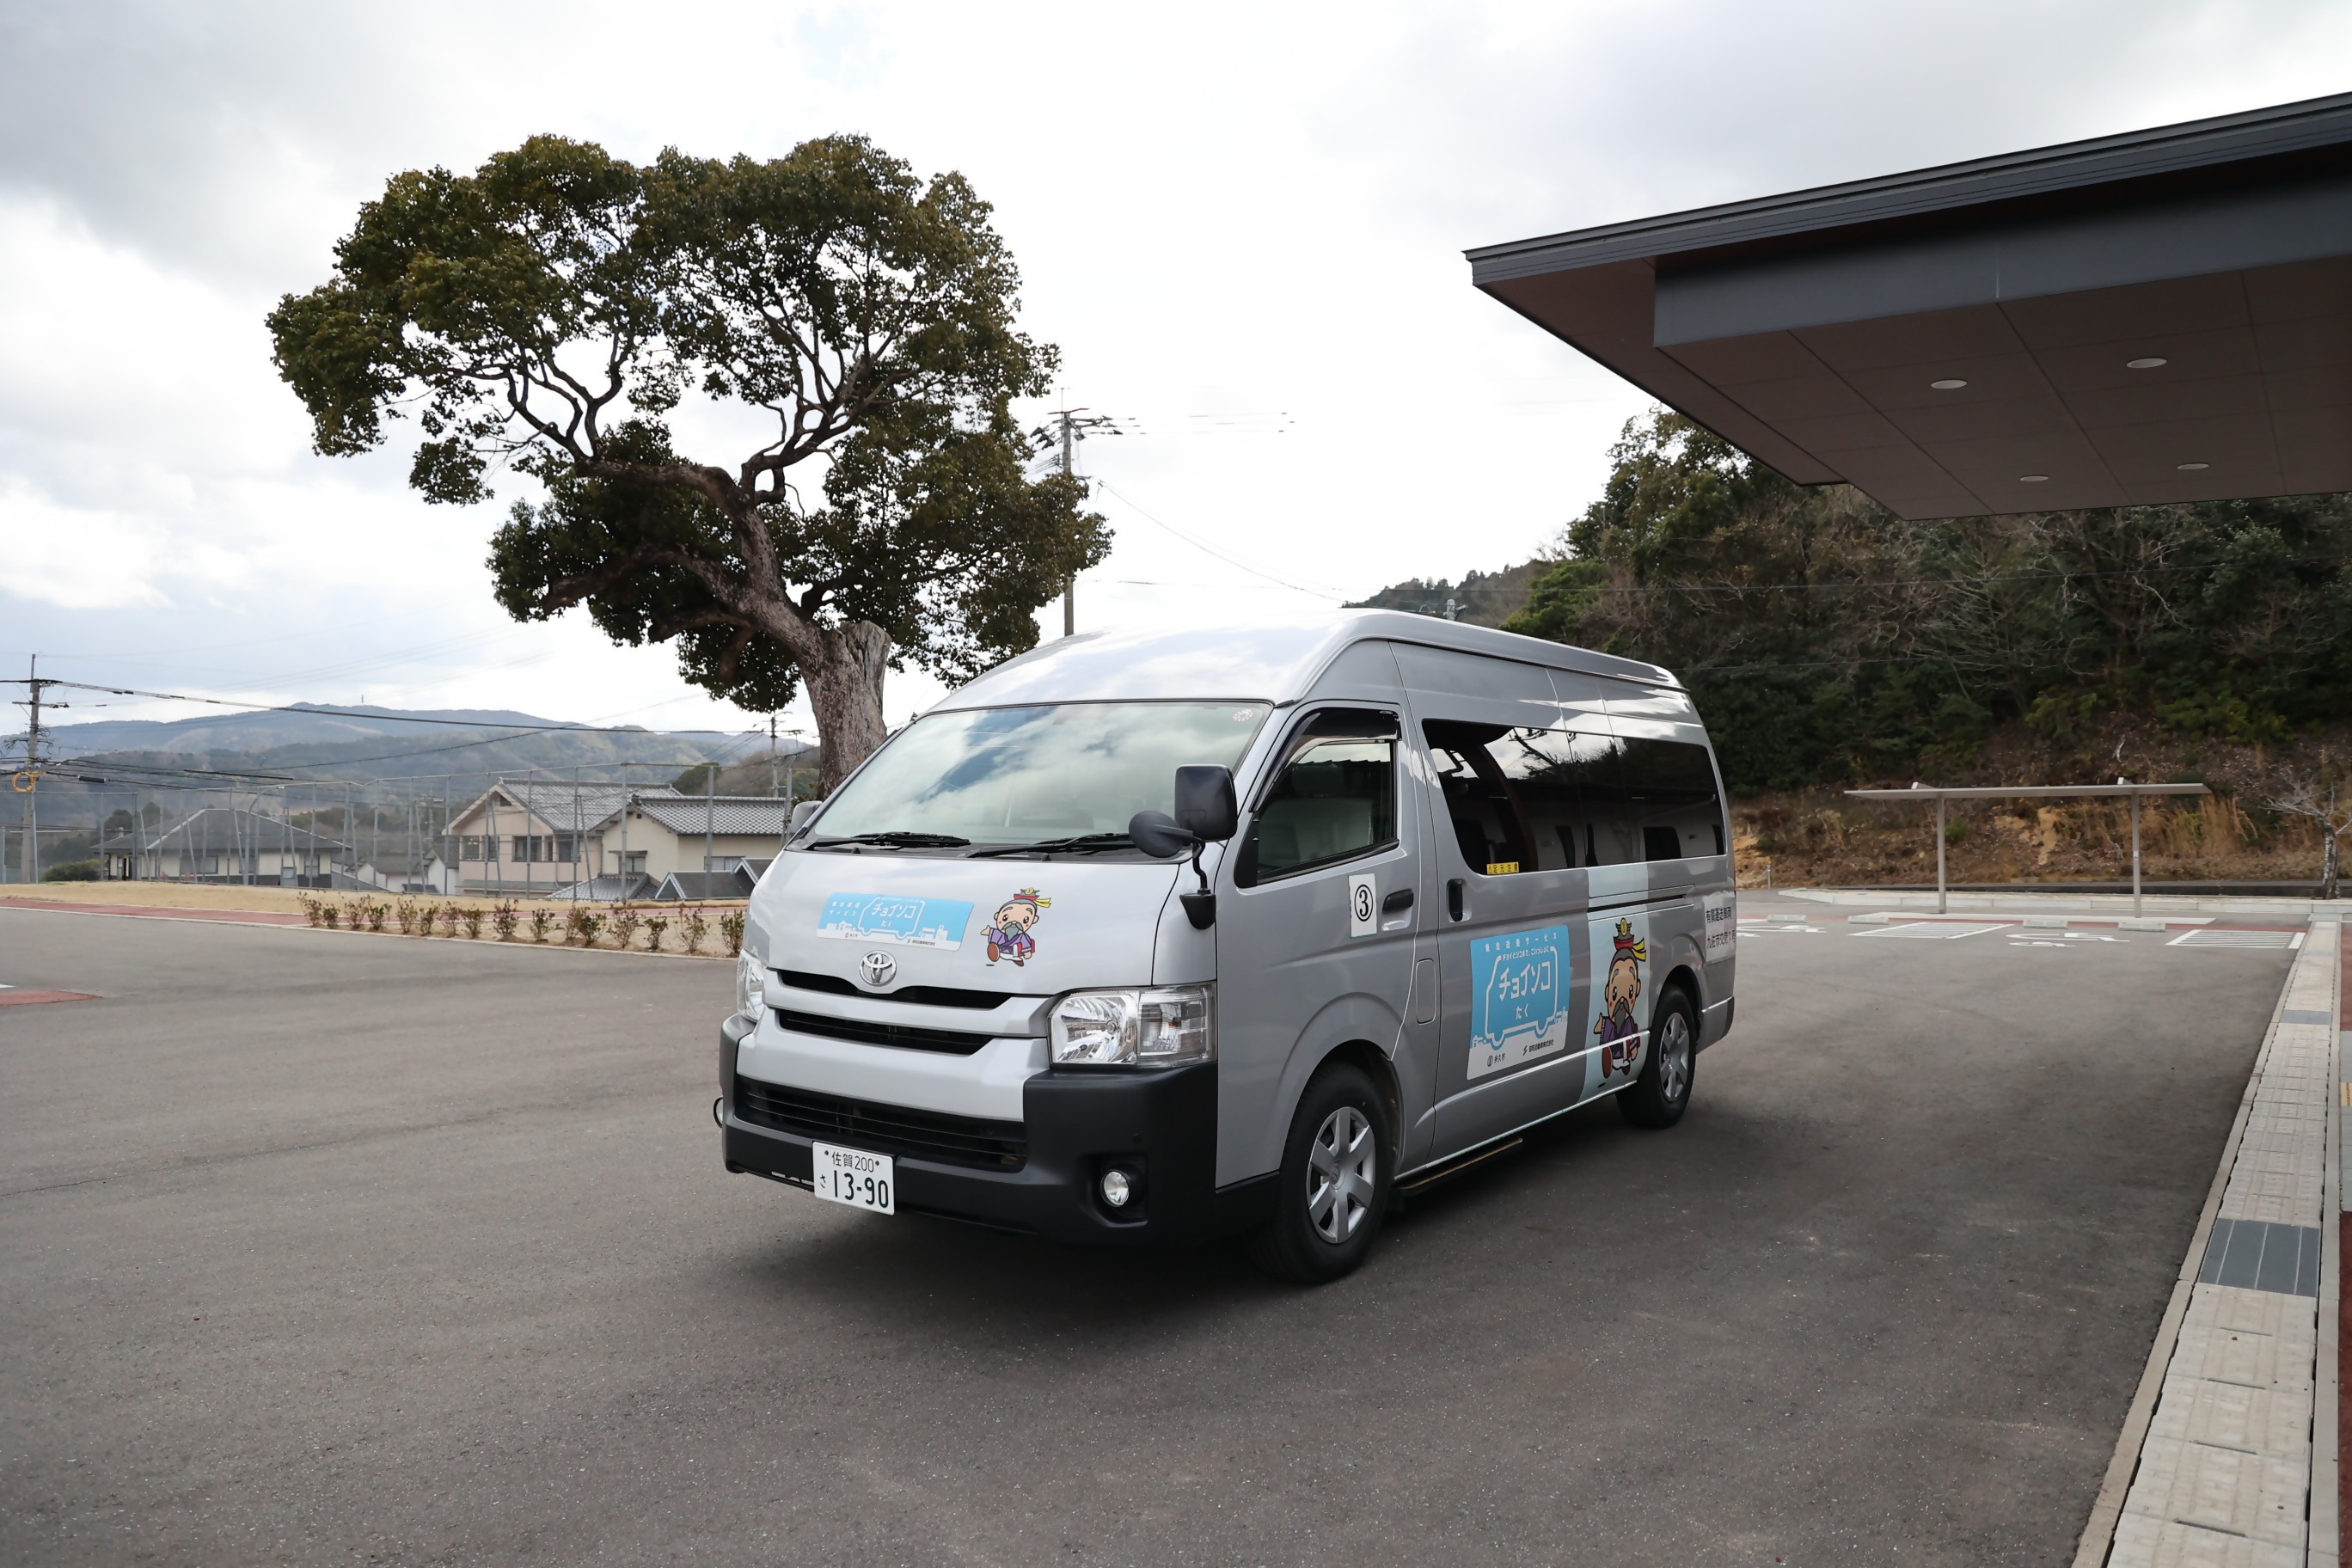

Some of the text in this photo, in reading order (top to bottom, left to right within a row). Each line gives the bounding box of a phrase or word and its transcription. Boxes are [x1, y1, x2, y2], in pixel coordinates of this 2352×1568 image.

[871, 903, 916, 919] チョイソコ
[1498, 961, 1551, 1001] チョイソコ
[1516, 1003, 1529, 1020] たく
[819, 1169, 889, 1209] さ 13-90
